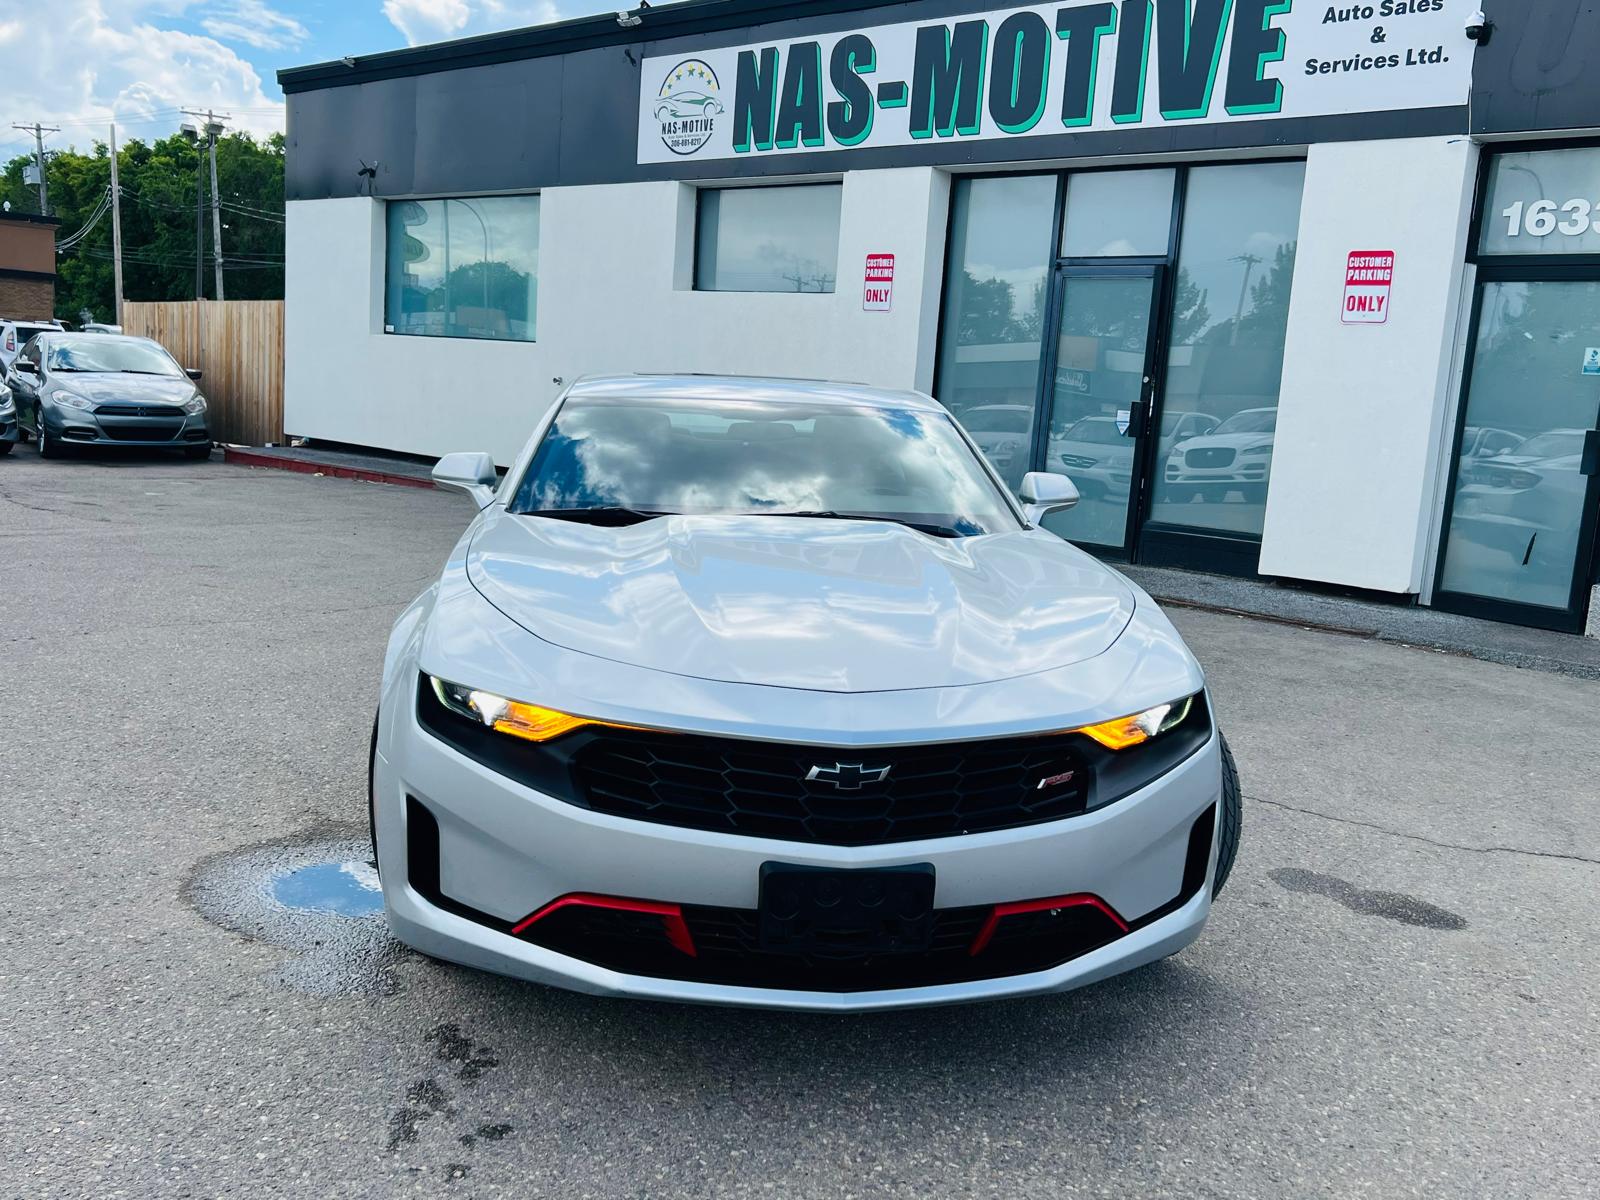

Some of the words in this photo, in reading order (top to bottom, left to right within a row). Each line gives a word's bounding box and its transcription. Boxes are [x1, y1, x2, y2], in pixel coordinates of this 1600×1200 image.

[1322, 5, 1374, 24] Auto
[1379, 0, 1443, 17] Sales
[1370, 26, 1387, 43] &
[1304, 53, 1400, 75] Services
[1405, 46, 1449, 66] Ltd.
[733, 0, 1292, 153] NAS-MOTIVE
[661, 119, 713, 135] NAS-MOTIVE
[1502, 198, 1600, 237] 163
[1348, 256, 1393, 268] CUSTOMER
[866, 268, 892, 277] PARKING
[1346, 269, 1391, 281] PARKING
[866, 288, 889, 302] ONLY
[1346, 295, 1386, 312] ONLY
